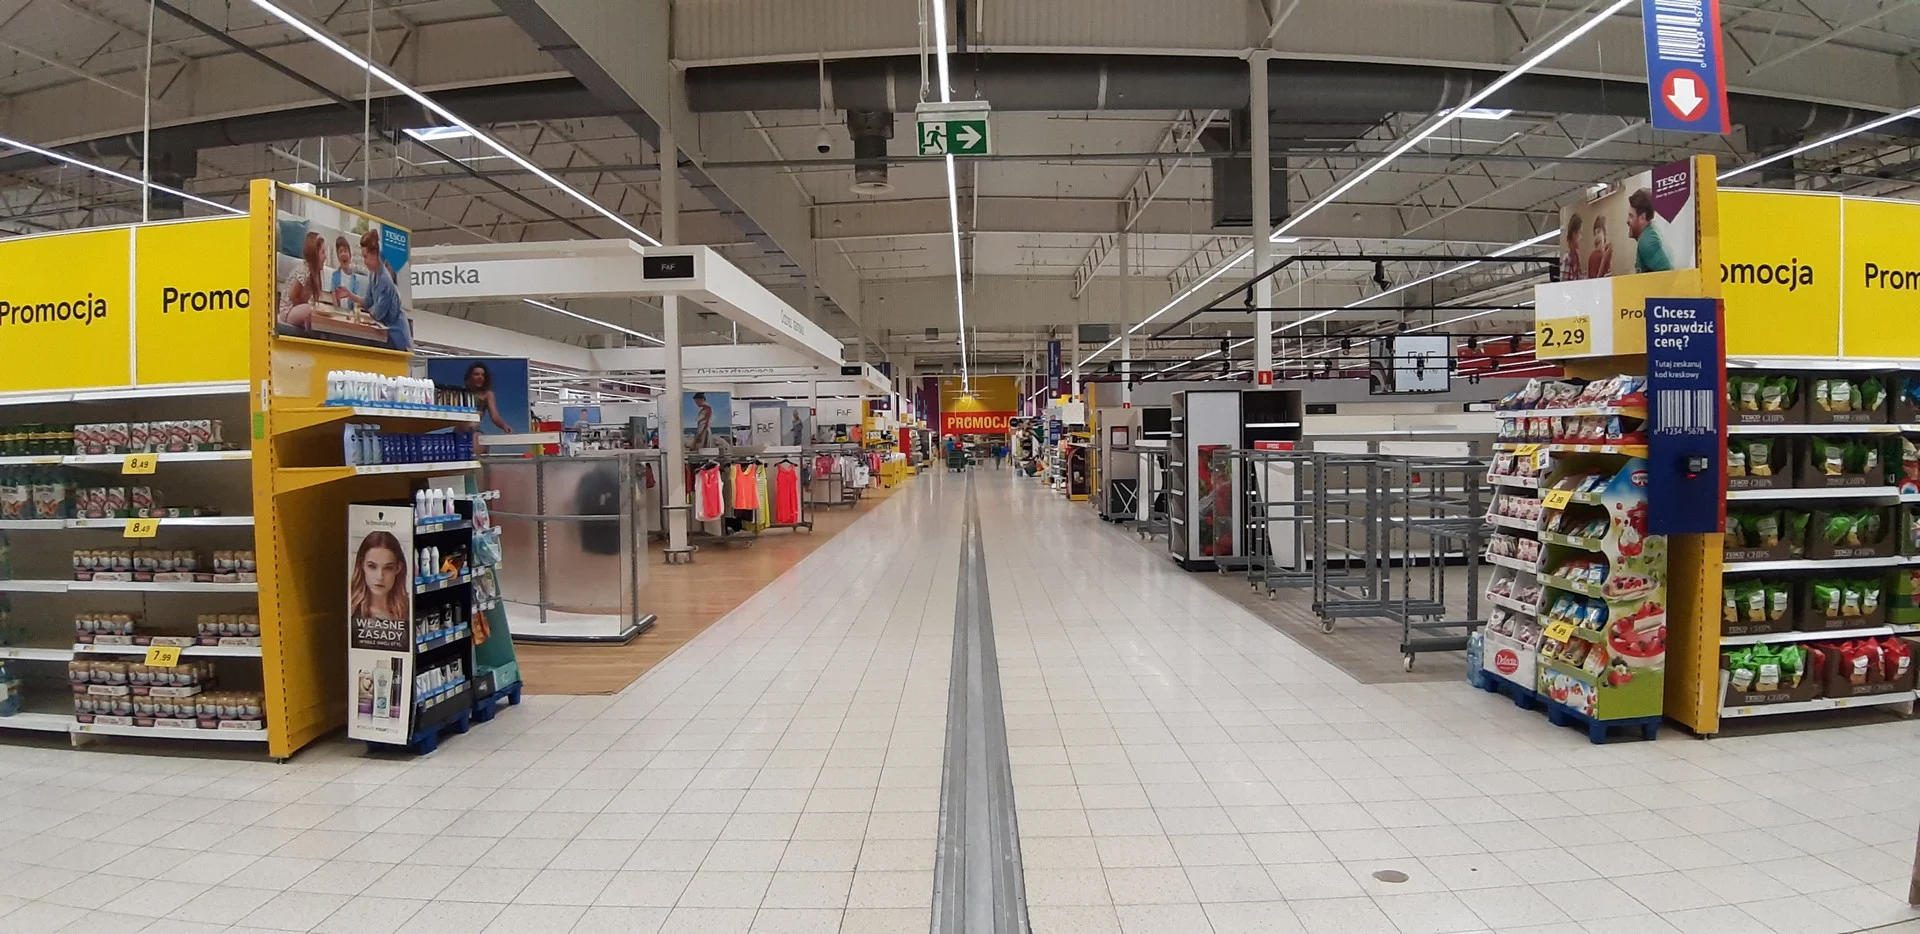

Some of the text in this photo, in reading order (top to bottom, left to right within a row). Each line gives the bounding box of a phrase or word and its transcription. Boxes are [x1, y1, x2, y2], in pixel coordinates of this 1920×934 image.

[1655, 171, 1688, 188] TESCO
[384, 229, 407, 244] TESCO
[163, 287, 250, 314] Promo
[0, 292, 107, 327] Promocja
[1620, 308, 1646, 320] Pro
[1653, 305, 1697, 319] Chcesz
[1653, 320, 1715, 336] sprawdzić
[1541, 327, 1585, 348] 2,29
[1654, 335, 1690, 351] cenę?
[1655, 360, 1702, 370] Tutaj zeskanuj
[1654, 371, 1700, 380] kod kreskowy
[836, 409, 853, 417] F&F
[757, 423, 774, 434] F&F
[947, 415, 1011, 430] PROMOCJ
[1664, 427, 1682, 435] 1234
[1687, 427, 1705, 435] 5678
[356, 618, 405, 631] WŁASNE
[358, 629, 403, 641] ZASADY
